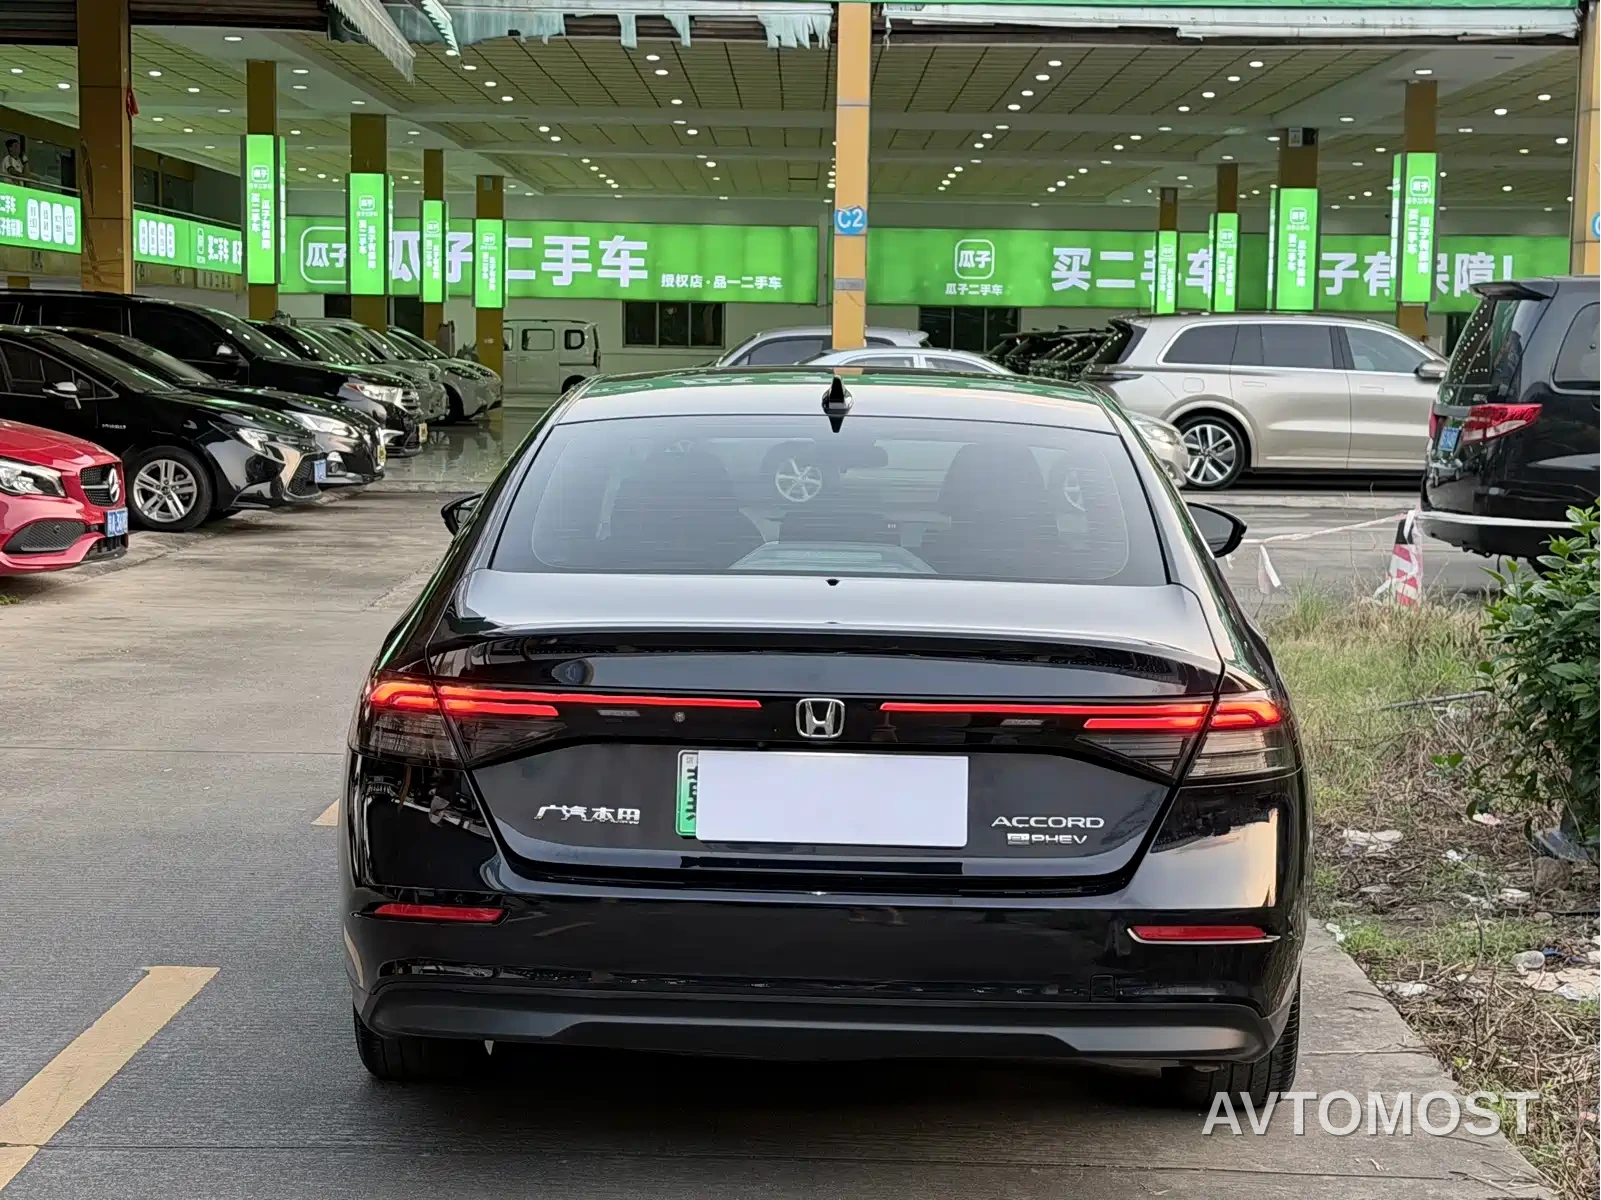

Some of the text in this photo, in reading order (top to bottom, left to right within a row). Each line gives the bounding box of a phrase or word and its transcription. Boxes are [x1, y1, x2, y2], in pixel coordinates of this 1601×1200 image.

[838, 208, 864, 229] C2
[959, 250, 991, 268] 瓜子
[945, 283, 1003, 296] 瓜子二手车
[534, 804, 641, 824] 广汽本田
[991, 816, 1105, 828] ACCORD
